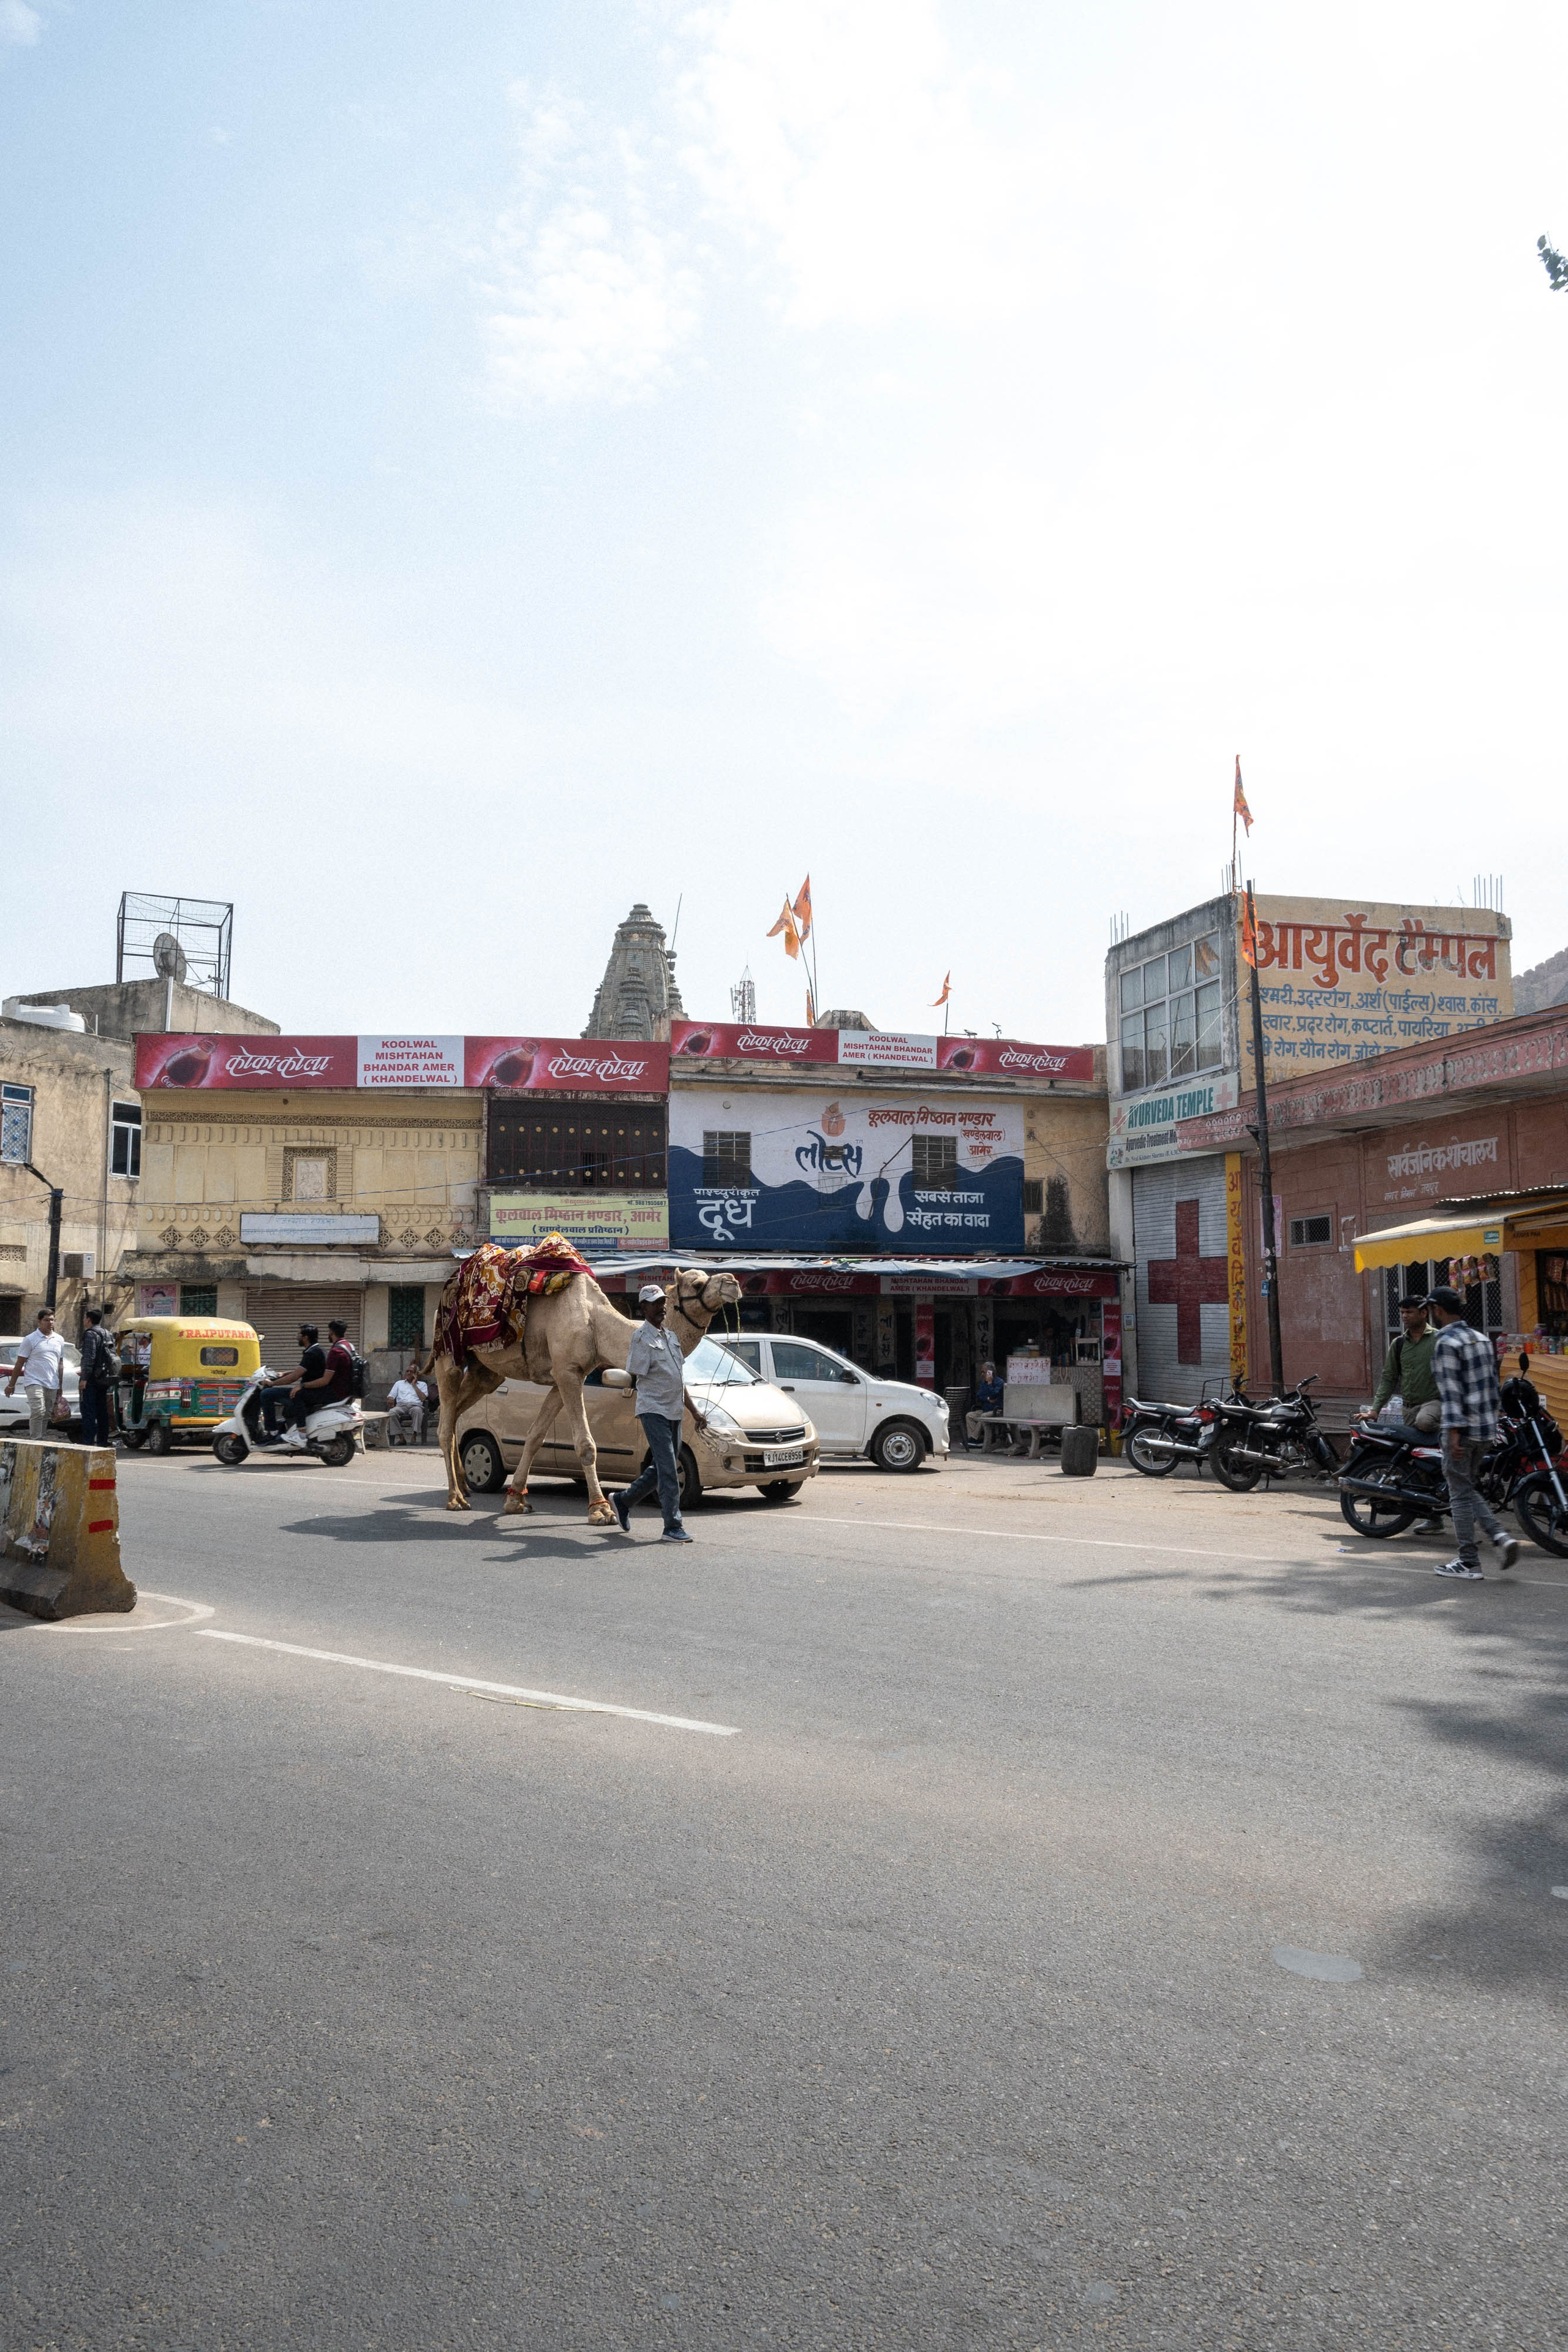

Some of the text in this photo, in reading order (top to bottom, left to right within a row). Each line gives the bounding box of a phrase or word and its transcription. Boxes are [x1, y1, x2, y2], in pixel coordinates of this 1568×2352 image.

[1256, 912, 1392, 989] आयुर्वेद
[381, 1040, 437, 1049] KOOLWAL
[869, 1035, 908, 1044] KOOLWAL
[843, 1042, 933, 1054] MISHTAHAN BHANDAR
[375, 1052, 443, 1060] MISHTAHAN
[873, 1053, 929, 1063] KHANDELWAL
[372, 1074, 451, 1084] KHANDELWAL
[1128, 1087, 1214, 1129] AYURVEDA TEMPLE
[868, 1106, 997, 1128] कूलवाल मिष्ठान भण्डार
[952, 1192, 984, 1204] ताजा
[495, 1208, 541, 1224] कूलवाल
[545, 1207, 584, 1221] मिष्ठान
[630, 1207, 662, 1223] आमेर
[696, 1199, 756, 1241] दूध
[906, 1207, 990, 1230] सेहत का वादा
[588, 1224, 623, 1234] प्रतिष्ठान
[186, 1329, 251, 1338] RAJPUTANA
[767, 1451, 802, 1463] RJ14CE8956
